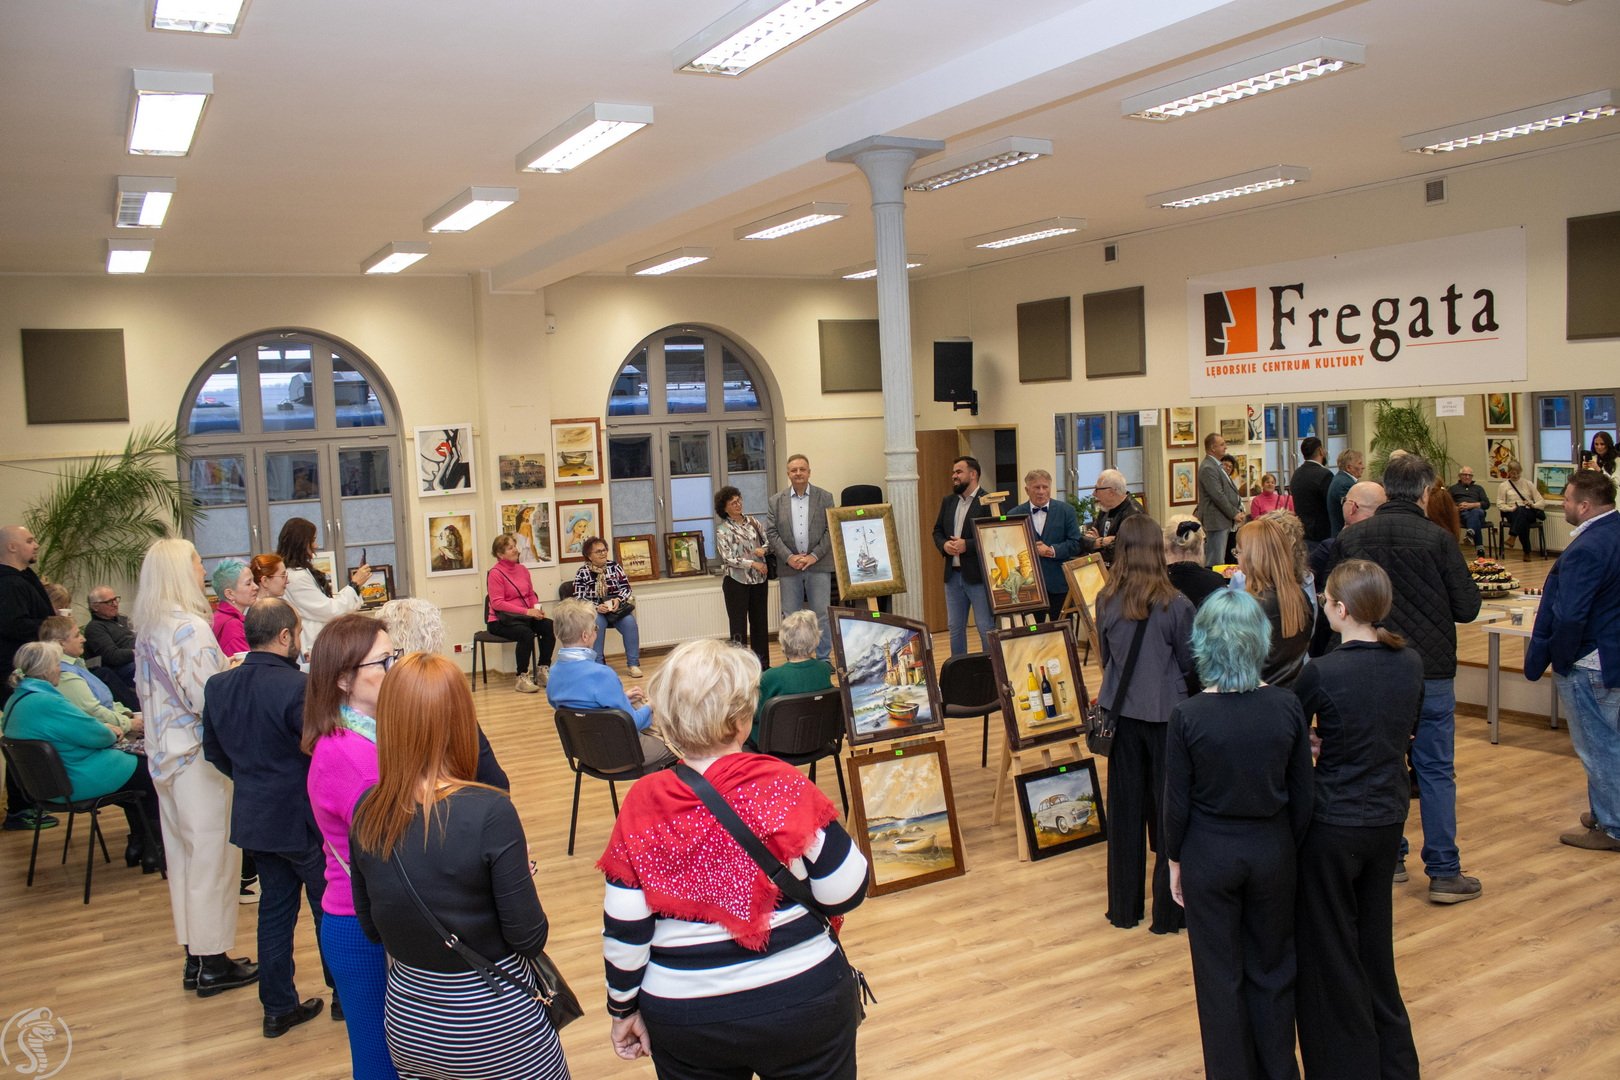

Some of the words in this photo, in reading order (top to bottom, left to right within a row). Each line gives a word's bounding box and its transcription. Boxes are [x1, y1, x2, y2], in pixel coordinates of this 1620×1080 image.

[1269, 283, 1500, 362] Fregata
[1206, 363, 1258, 379] LĘBORSKIE
[1263, 359, 1312, 373] CENTRUM
[1315, 355, 1366, 369] KULTURY
